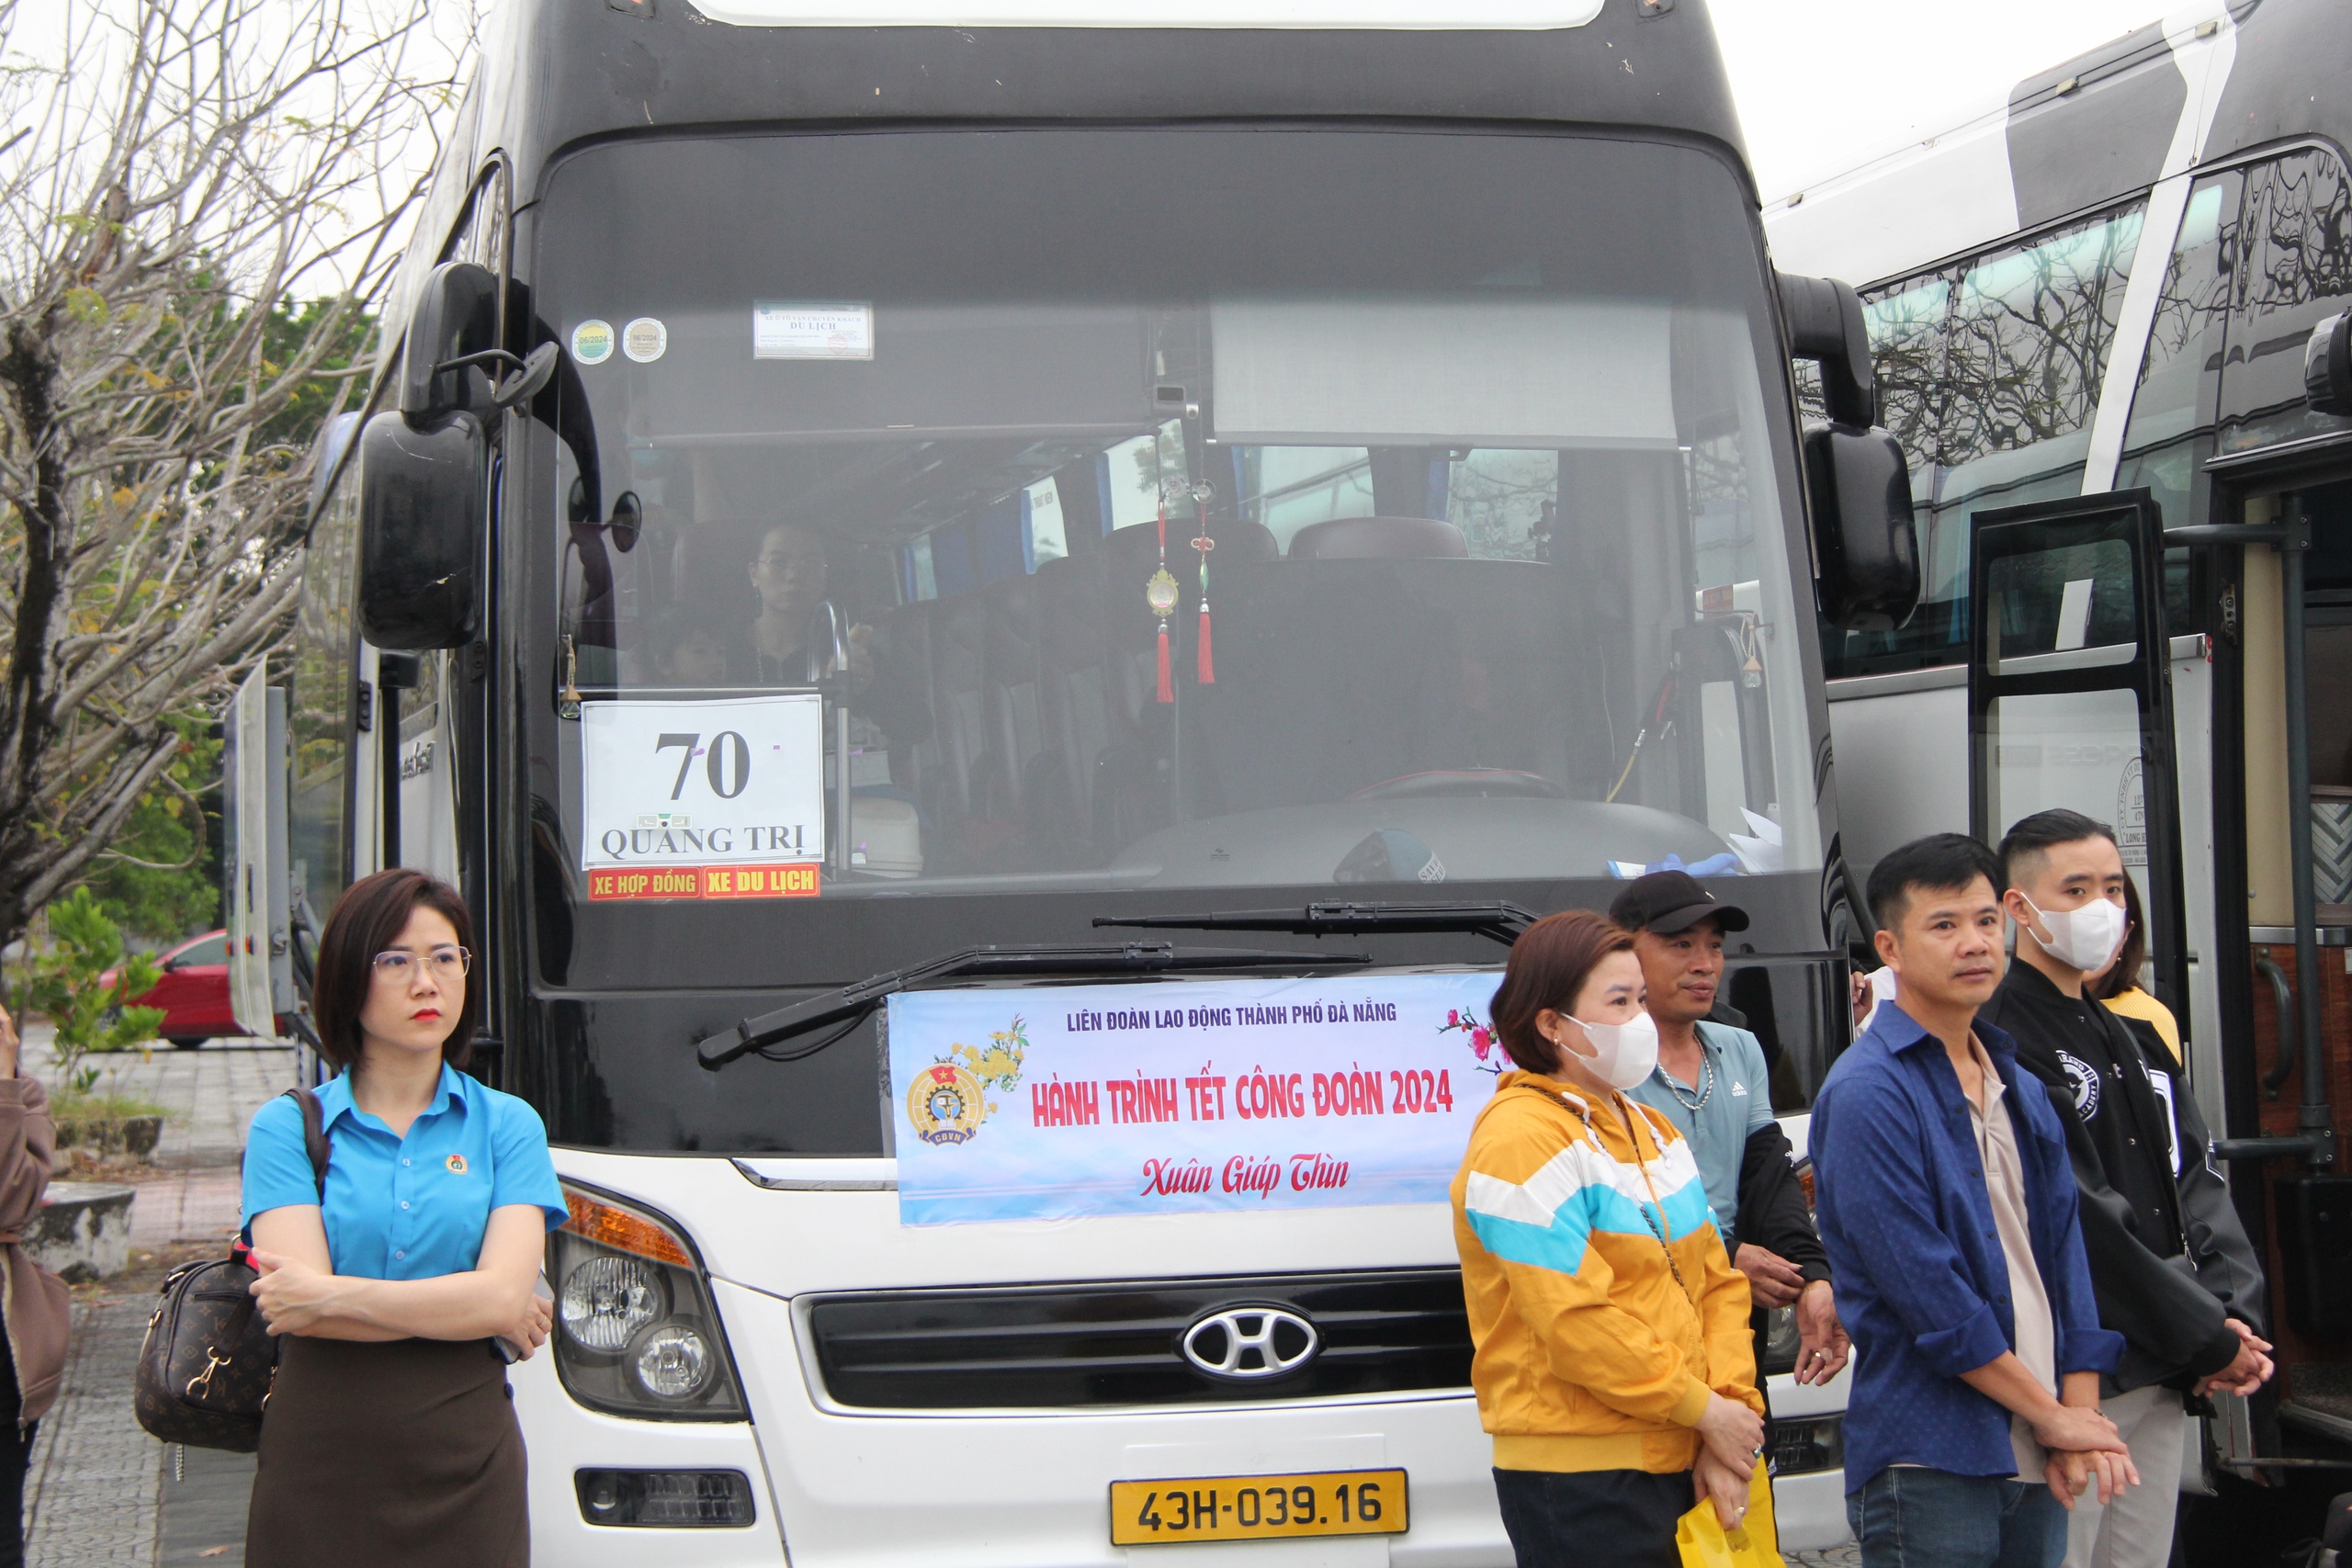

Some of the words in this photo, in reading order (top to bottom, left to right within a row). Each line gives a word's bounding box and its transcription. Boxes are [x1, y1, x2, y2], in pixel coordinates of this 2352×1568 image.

[580, 335, 607, 344] 06/2024
[790, 321, 805, 330] DU
[808, 321, 836, 332] LỊCH
[655, 730, 751, 801] 70
[743, 825, 806, 856] TRỊ
[594, 875, 614, 895] XE
[617, 874, 649, 897] HỢP
[652, 869, 696, 893] ĐỒNG
[707, 872, 731, 892] XE
[737, 872, 764, 892] DU
[771, 870, 814, 895] LỊCH
[1067, 1009, 1102, 1032] LIÊN
[1106, 1007, 1150, 1031] ĐOÀN
[1155, 1009, 1183, 1029] LAO
[1188, 1004, 1232, 1032] ĐỘNG
[1236, 1002, 1287, 1026] THÀNH
[1292, 998, 1323, 1024] PHỐ
[1328, 1000, 1349, 1023] ĐÀ
[1353, 997, 1397, 1022] NẴNG
[1031, 1072, 1100, 1127] HÀNH
[1106, 1068, 1179, 1124] TRÌNH
[1185, 1059, 1227, 1122] TẾT
[1236, 1064, 1306, 1120] CÔNG
[1312, 1061, 1385, 1117] ĐOÀN
[1390, 1069, 1453, 1114] 2024
[1139, 1157, 1215, 1196] Xuân
[1222, 1155, 1282, 1201] Giáp
[1289, 1152, 1351, 1191] Thìn
[1138, 1483, 1382, 1531] 43H-039.16
